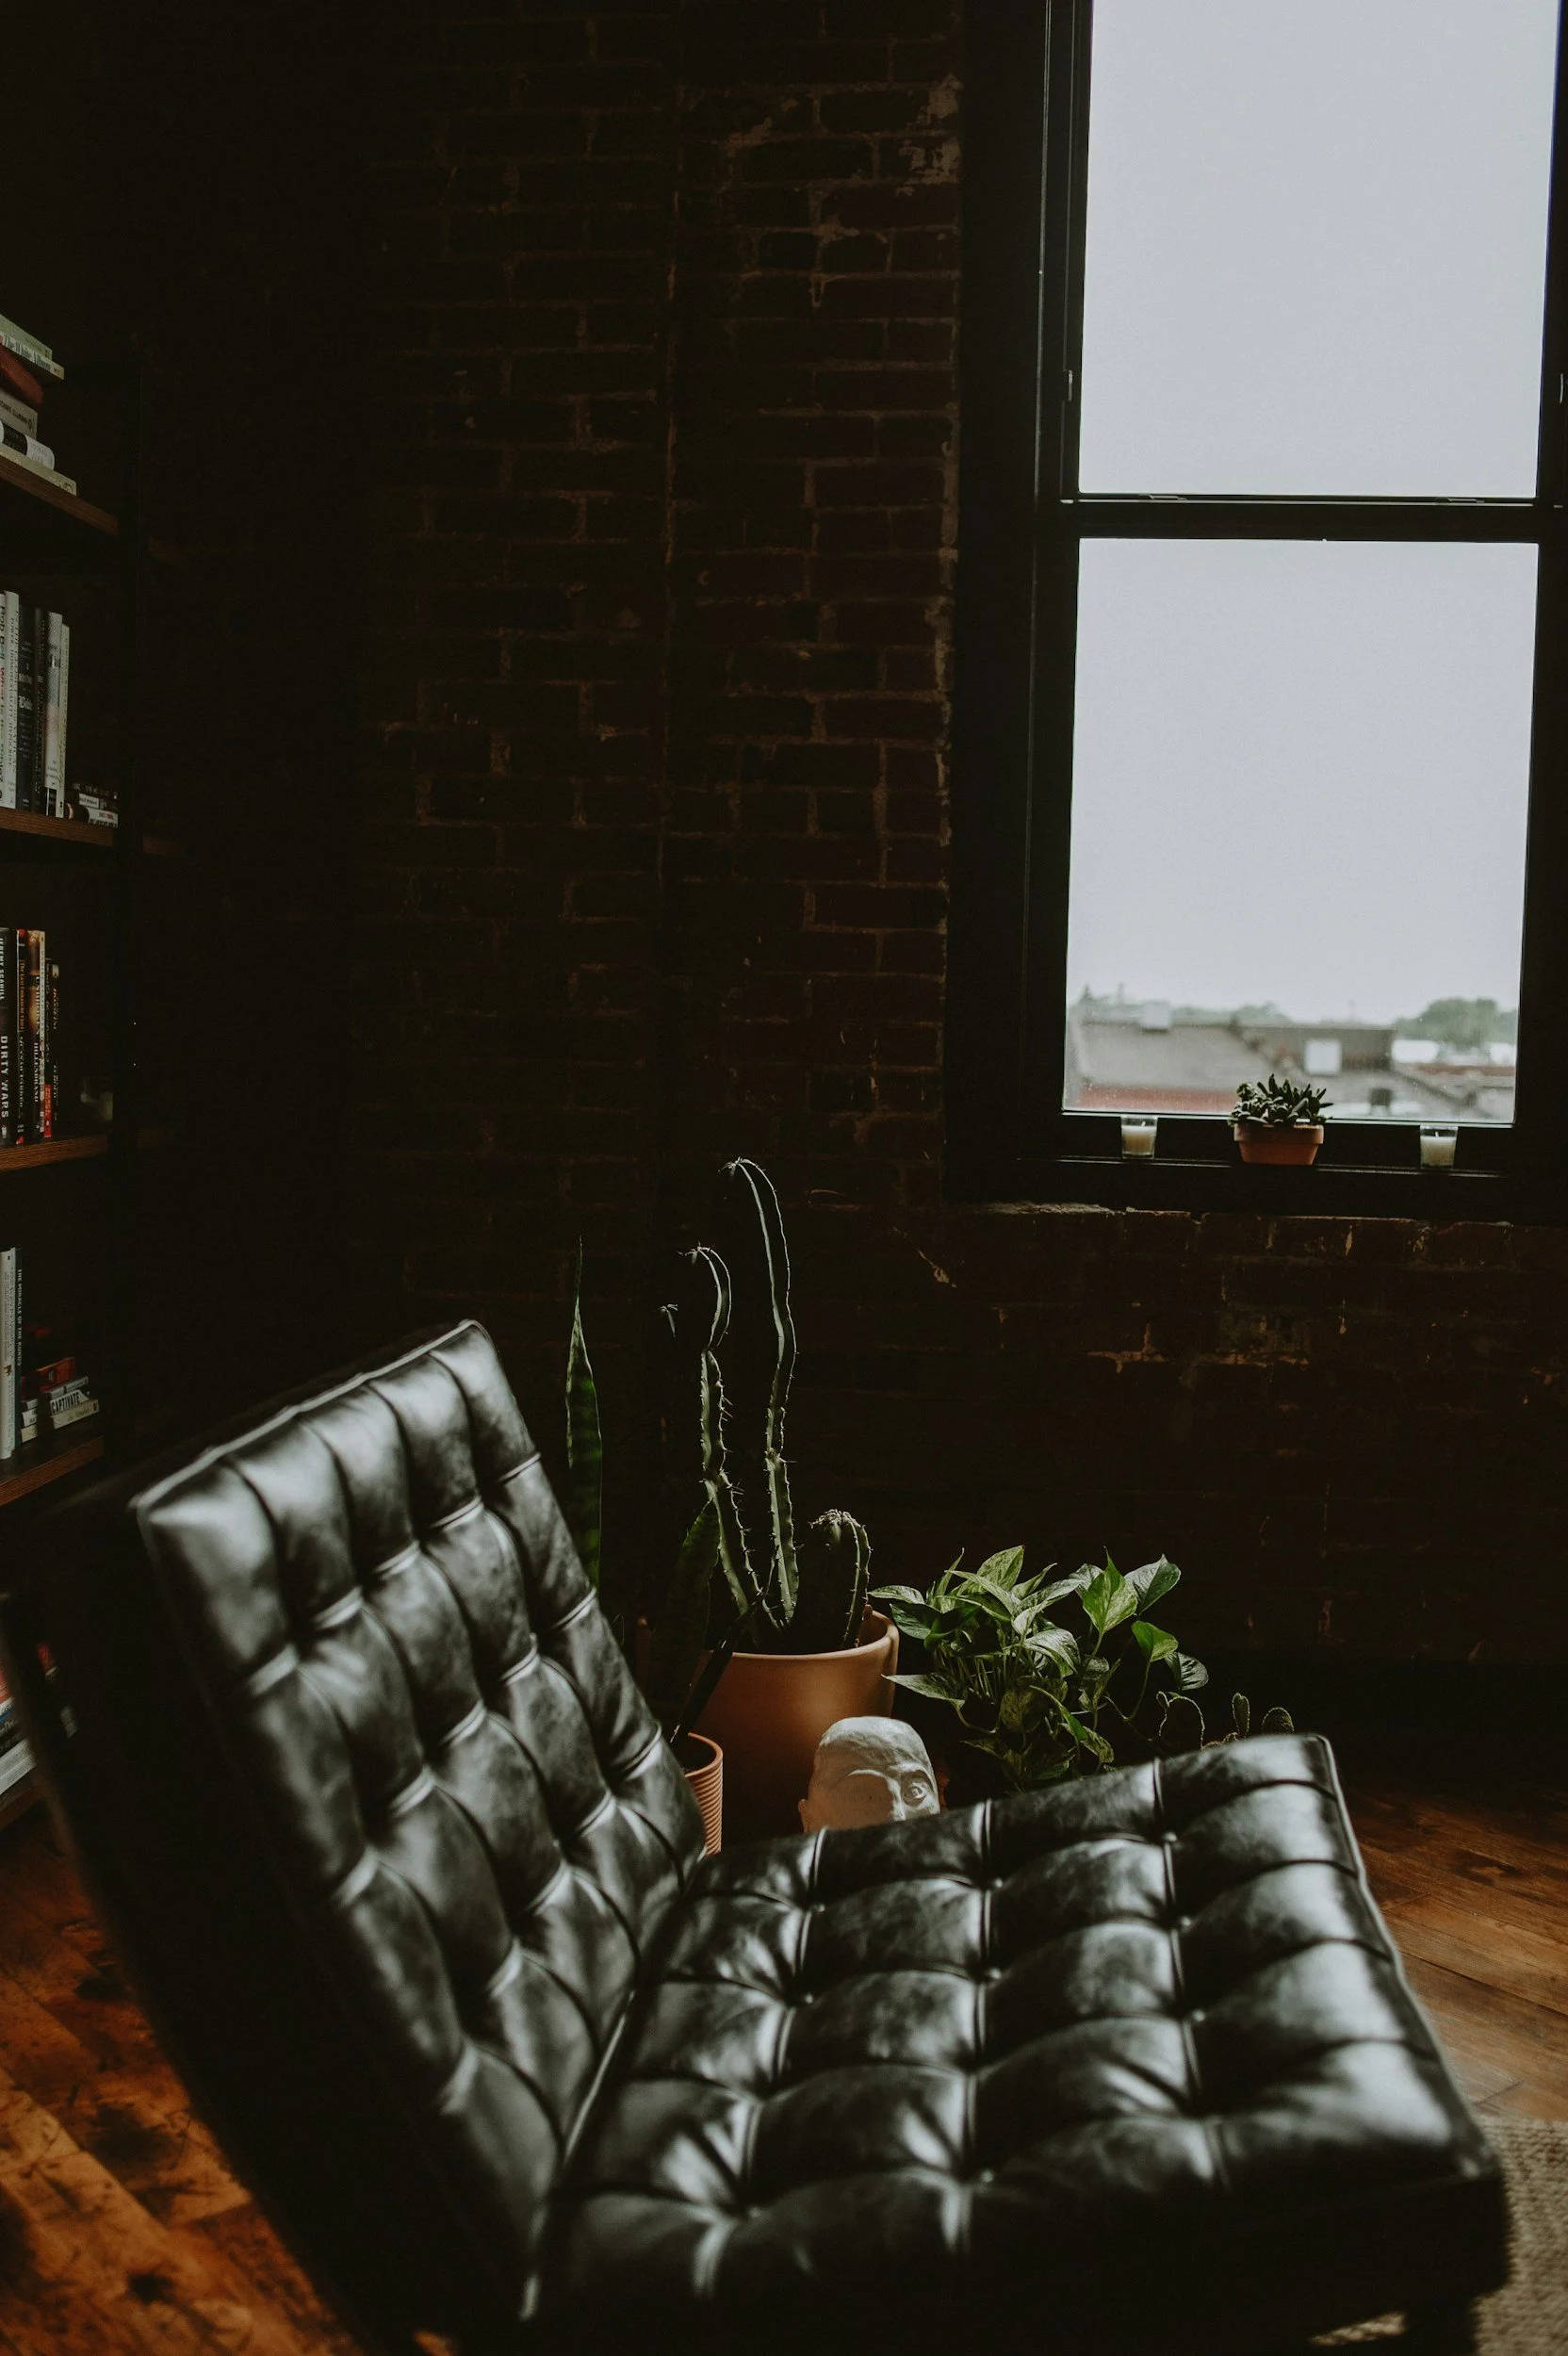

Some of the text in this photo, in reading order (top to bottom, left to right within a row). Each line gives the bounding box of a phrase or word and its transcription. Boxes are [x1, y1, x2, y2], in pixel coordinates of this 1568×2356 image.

[1, 1080, 9, 1119] WARS
[17, 1316, 22, 1324] OF
[52, 1392, 80, 1414] CAPTIVATE
